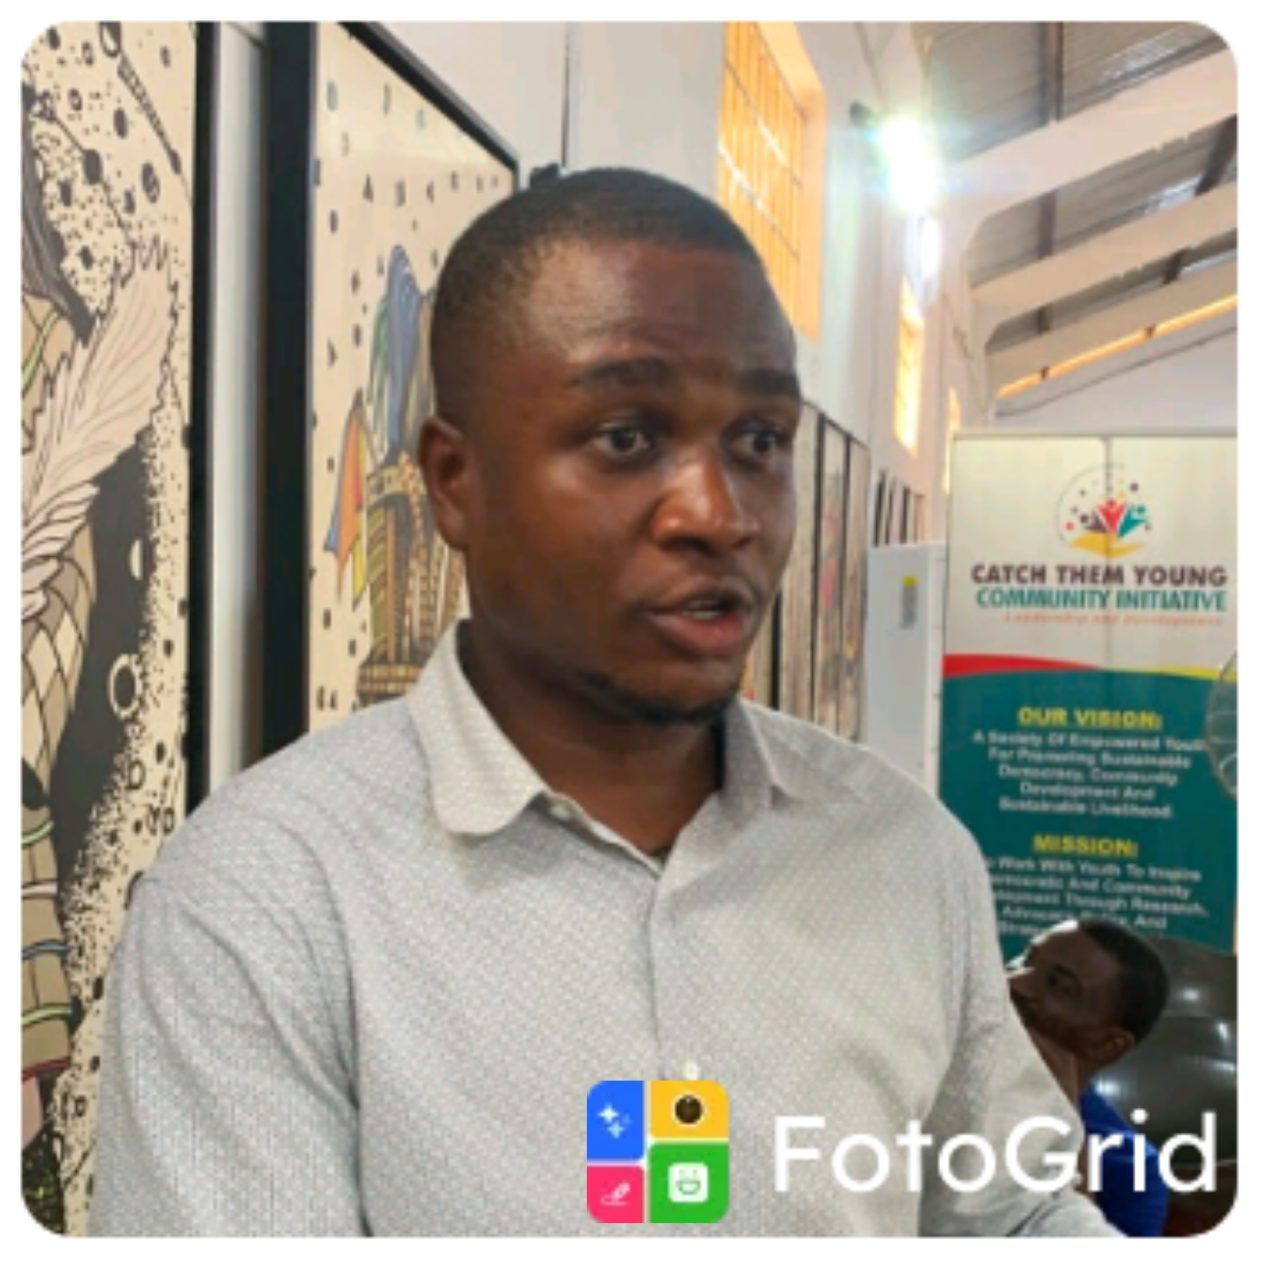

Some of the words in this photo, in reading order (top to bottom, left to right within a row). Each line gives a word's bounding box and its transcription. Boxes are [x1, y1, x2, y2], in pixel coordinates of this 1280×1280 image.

[972, 564, 1047, 584] CATCH
[1056, 565, 1125, 585] THEM
[1134, 566, 1228, 587] YOUNG
[976, 587, 1110, 609] COMMUNITY
[1116, 589, 1228, 612] INITIATIVE
[1017, 706, 1068, 727] OUR
[1073, 708, 1164, 730] VISION:
[1033, 834, 1139, 858] MISSION:
